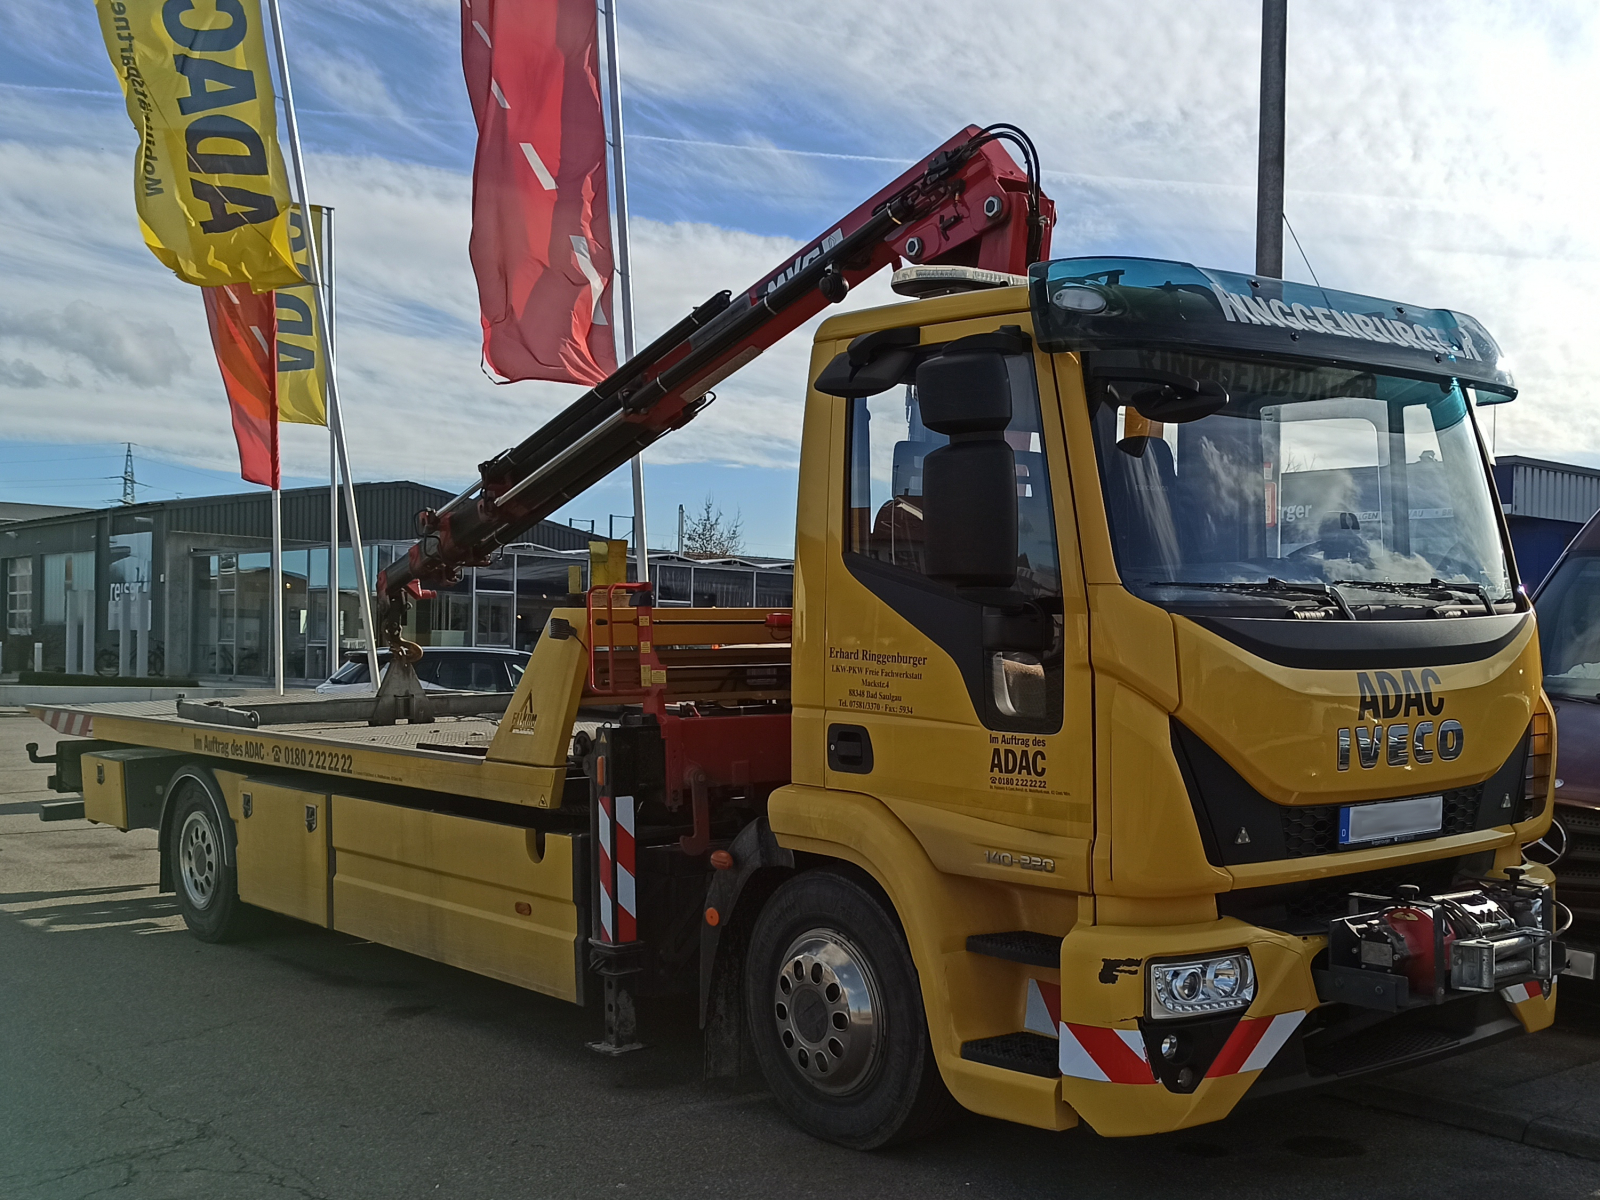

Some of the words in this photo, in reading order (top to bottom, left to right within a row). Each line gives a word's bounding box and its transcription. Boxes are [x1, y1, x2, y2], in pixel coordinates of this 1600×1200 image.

[1278, 504, 1312, 522] rger
[829, 646, 859, 661] Erhard
[861, 649, 928, 669] Ringgenburger
[831, 664, 863, 675] LKW-PKW
[865, 667, 880, 677] Freie
[880, 668, 923, 680] Fachwerkstatt
[866, 690, 878, 700] Bad
[878, 691, 902, 703] Saulgau
[1356, 668, 1445, 721] ADAC
[898, 705, 914, 715] 5934
[989, 733, 999, 745] Im
[1000, 735, 1030, 748] Auftrag
[1031, 735, 1047, 747] des
[1337, 718, 1465, 773] IVECO
[193, 733, 203, 750] Im
[203, 734, 230, 758] Auftrag
[230, 739, 244, 758] des
[244, 740, 265, 761] ADAC
[284, 745, 306, 768] 0180
[989, 747, 1047, 777] ADAC
[998, 777, 1014, 786] 0180
[1341, 828, 1347, 837] D
